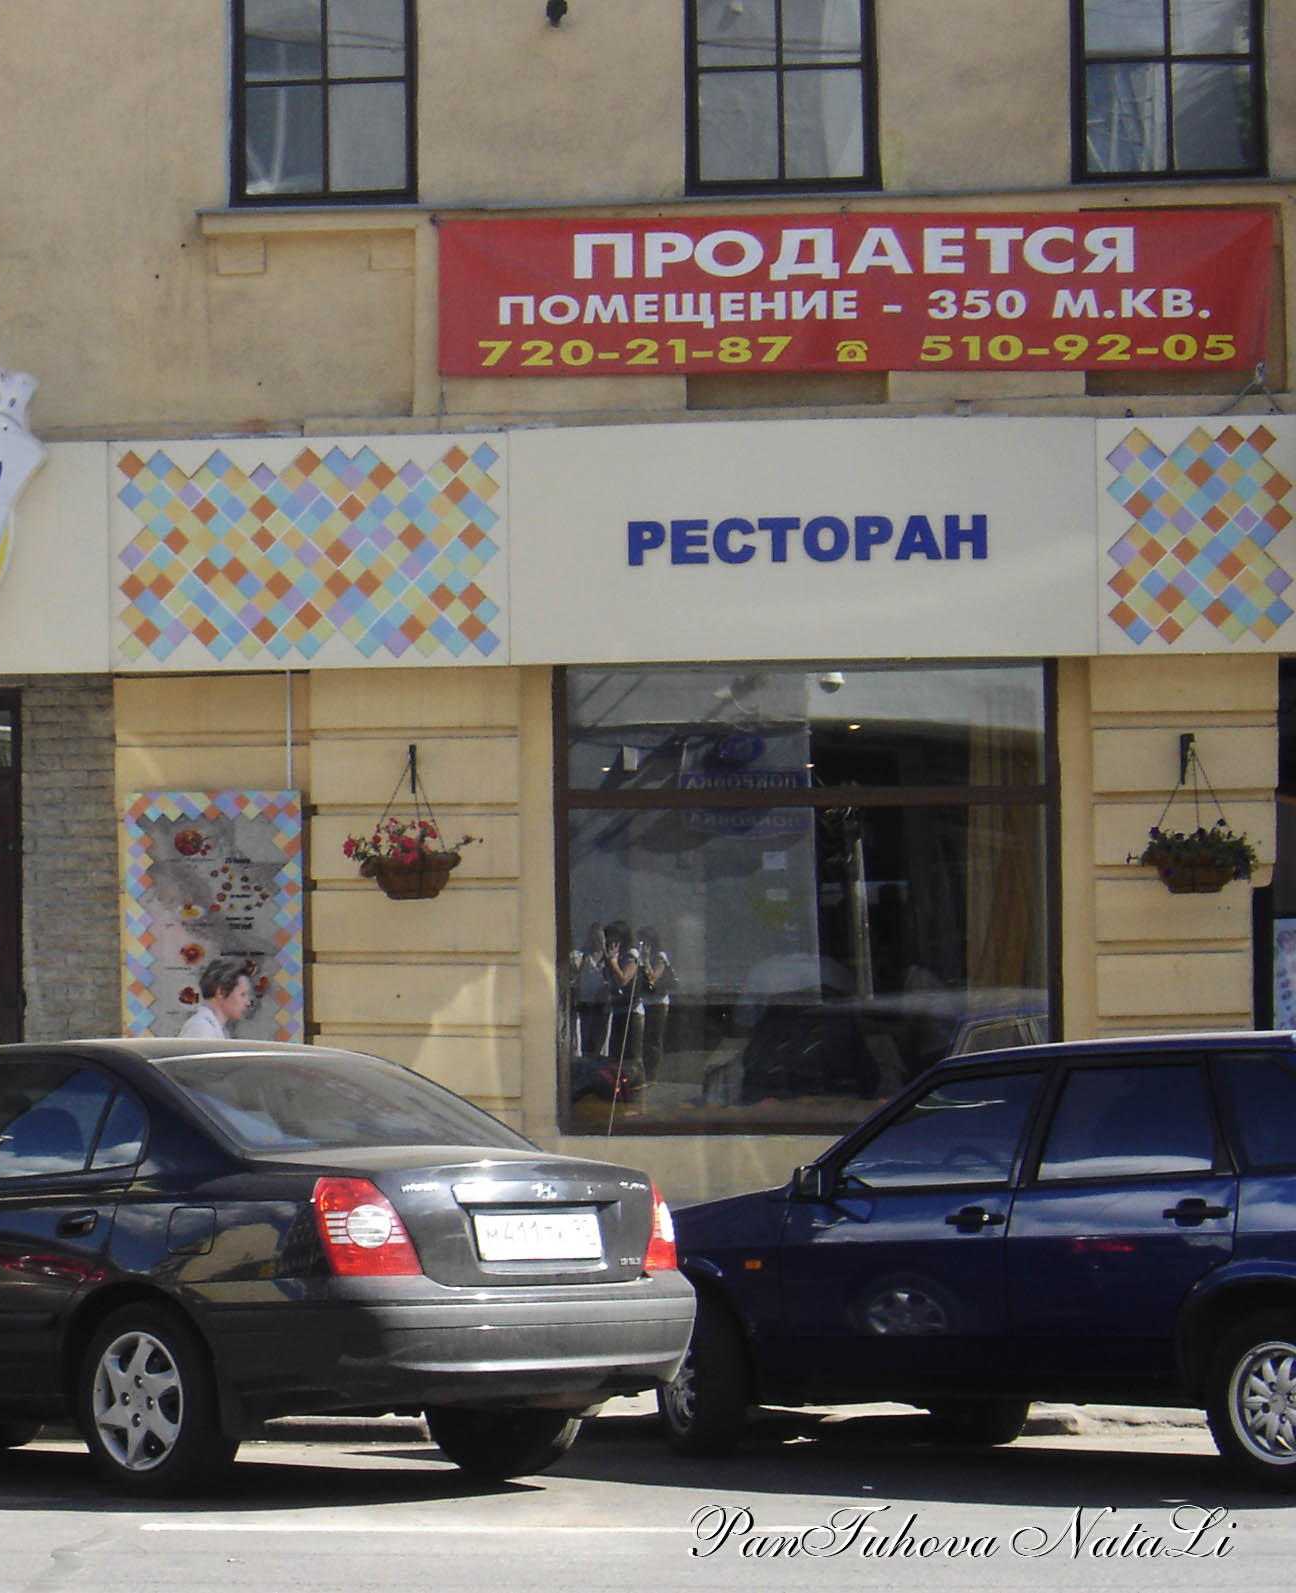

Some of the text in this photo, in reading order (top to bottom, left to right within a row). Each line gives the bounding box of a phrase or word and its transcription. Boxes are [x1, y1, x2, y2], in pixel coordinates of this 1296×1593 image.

[572, 226, 1135, 281] ПРОДАЕТСЯ
[498, 289, 858, 329] ПОМЕЩЕНИЕ
[927, 289, 1027, 319] 350
[1051, 288, 1211, 319] М.КВ.
[477, 333, 1237, 367] 720-21-87 510-92-05
[627, 514, 988, 566] РЕСТОРАН
